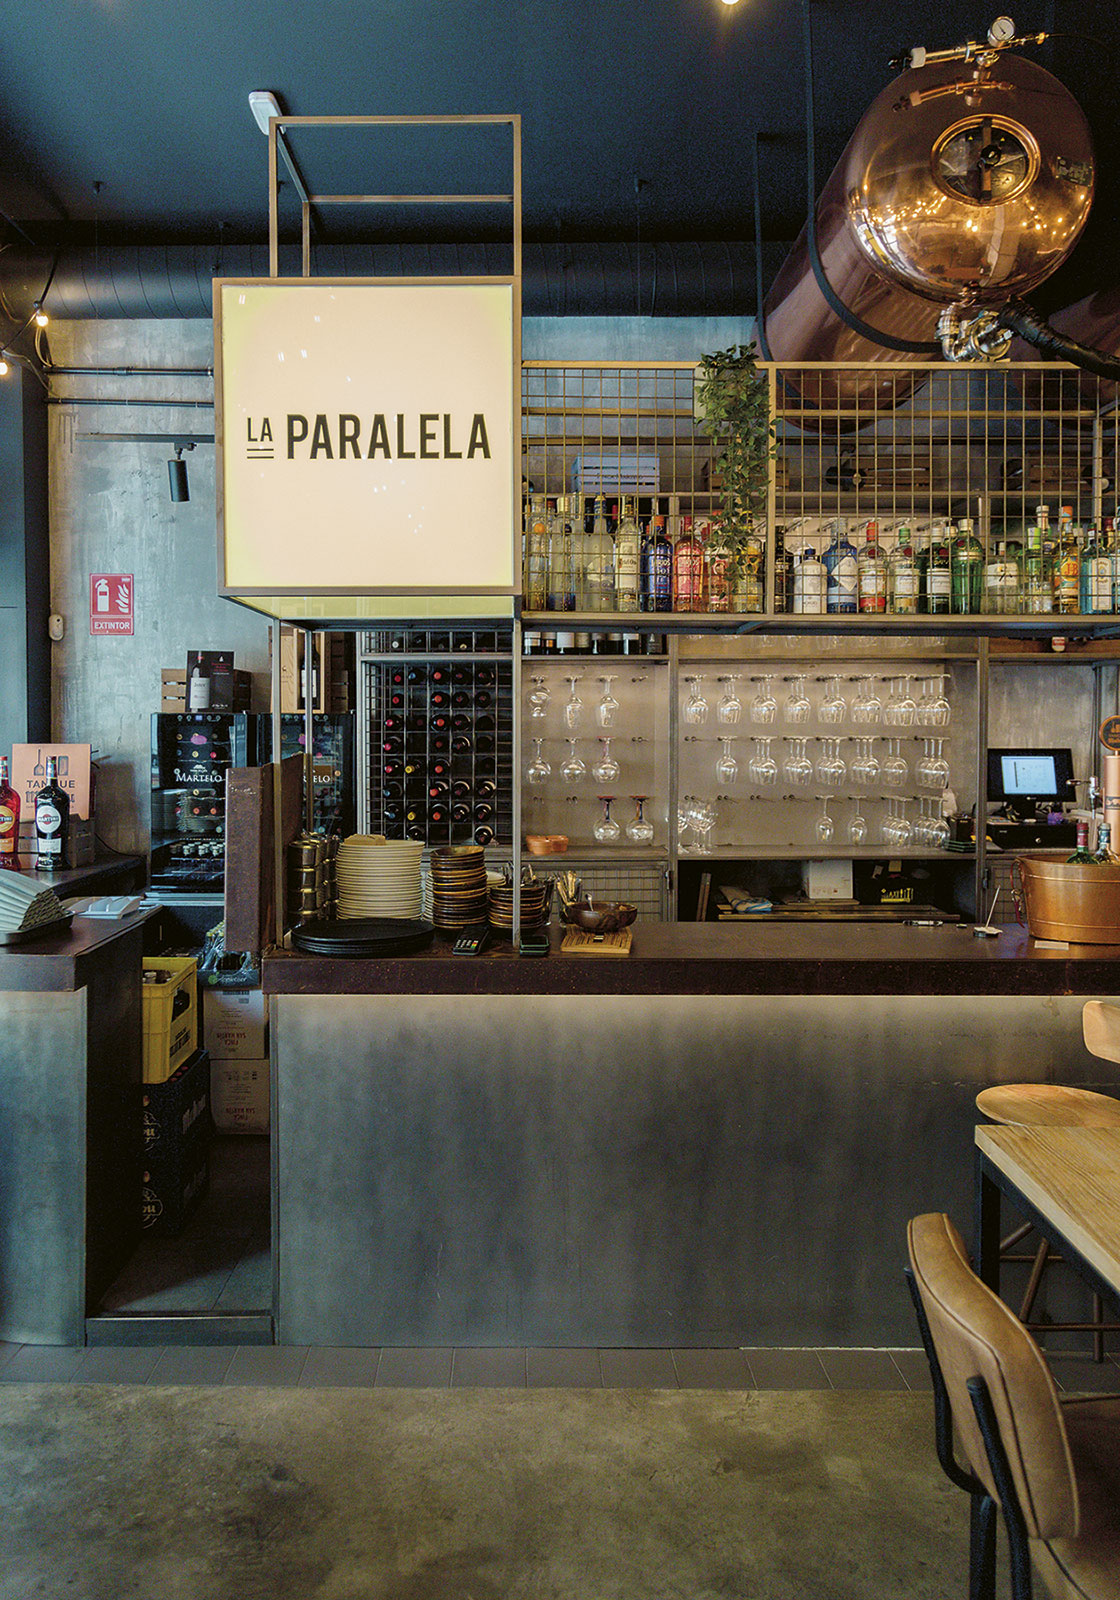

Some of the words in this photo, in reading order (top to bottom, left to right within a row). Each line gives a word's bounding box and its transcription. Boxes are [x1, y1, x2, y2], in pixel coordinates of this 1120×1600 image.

[246, 417, 274, 443] LA
[286, 413, 492, 460] PARALELA
[94, 621, 130, 630] EXTINTOR
[176, 772, 223, 783] MARTELO
[26, 779, 76, 789] TANUE
